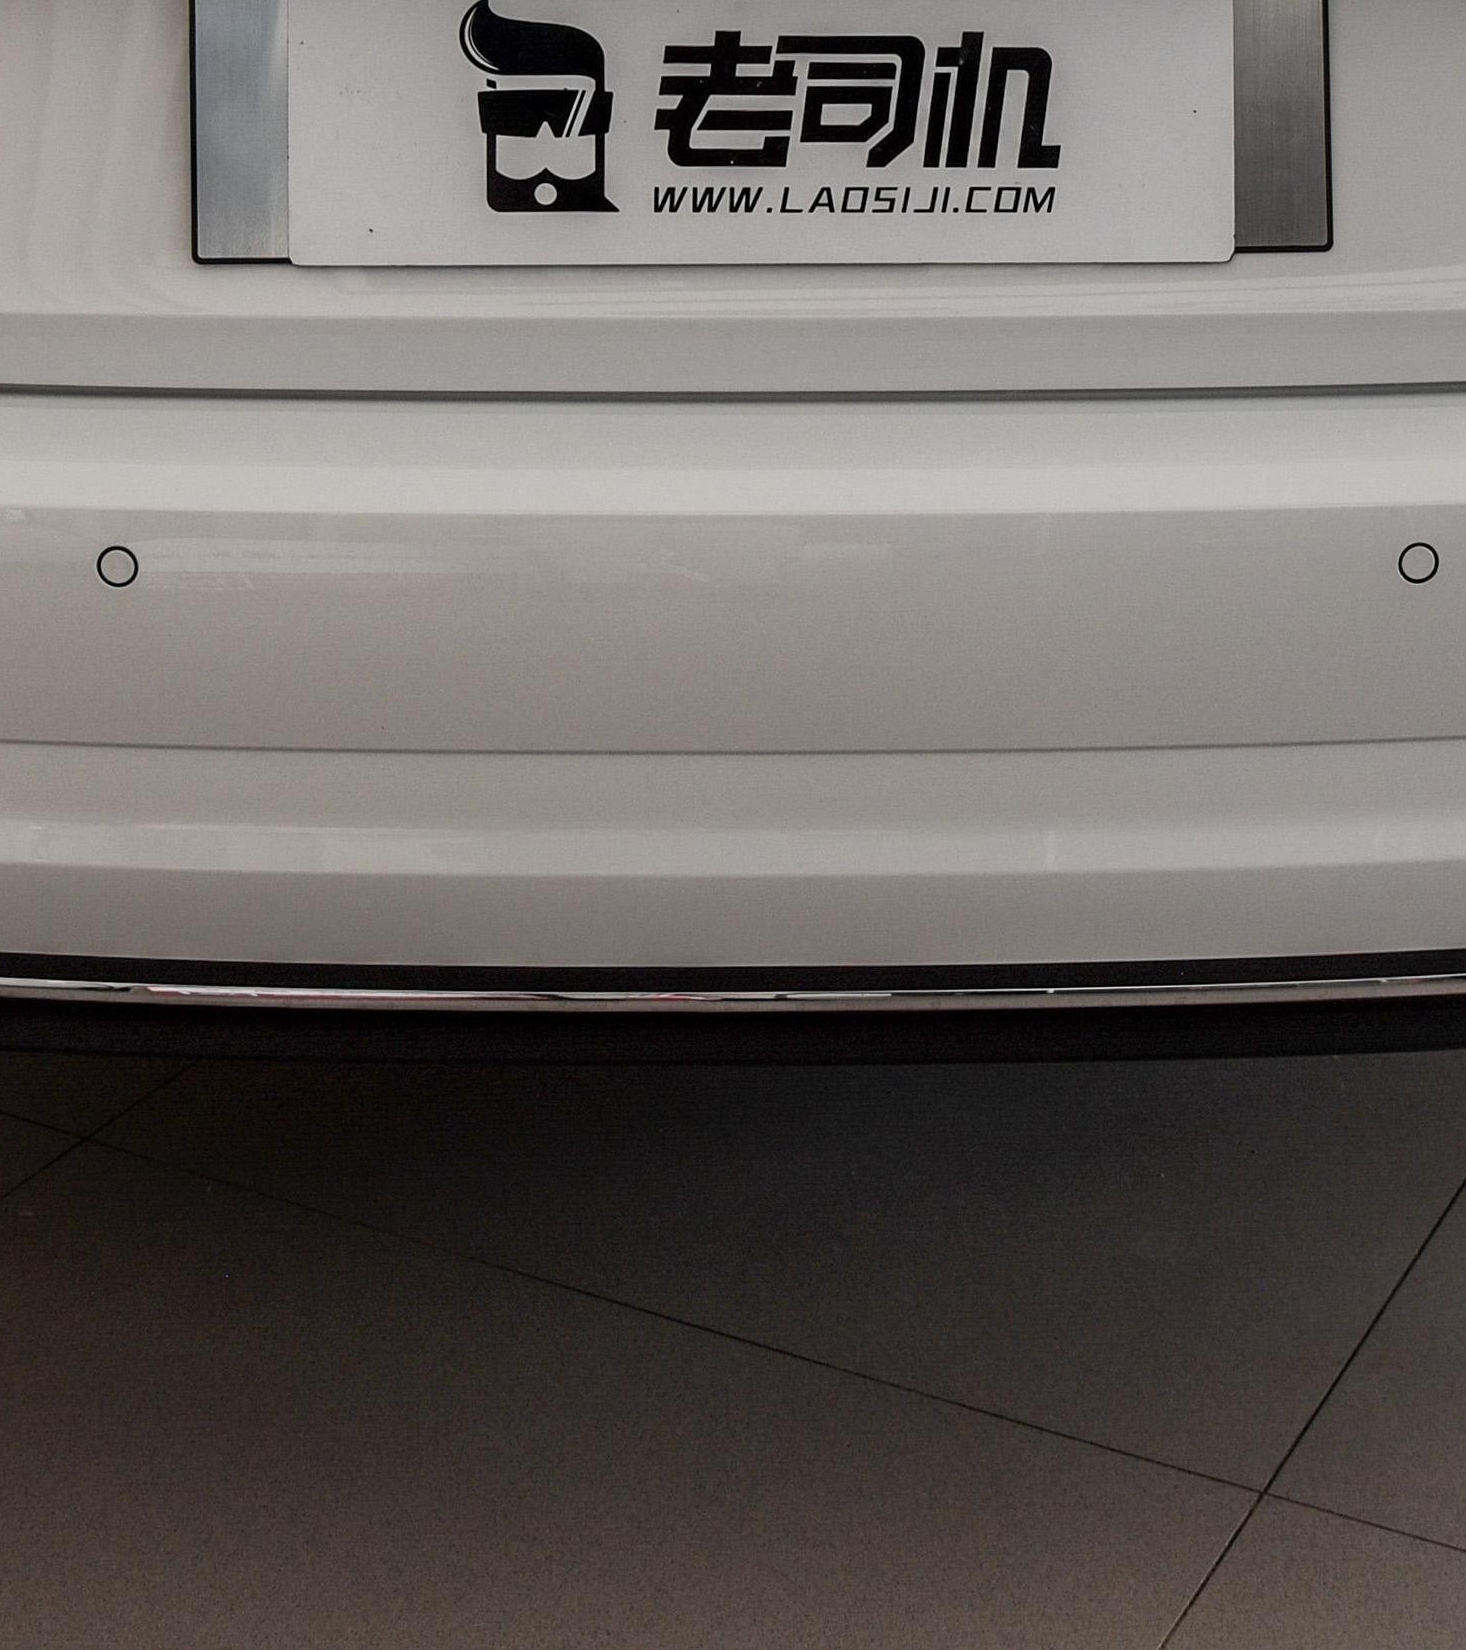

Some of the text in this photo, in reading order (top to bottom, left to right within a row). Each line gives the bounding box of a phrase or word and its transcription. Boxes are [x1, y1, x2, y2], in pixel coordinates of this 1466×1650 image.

[654, 30, 1061, 168] 老司机
[654, 186, 1056, 213] WWW.LAOSIJI.COM
